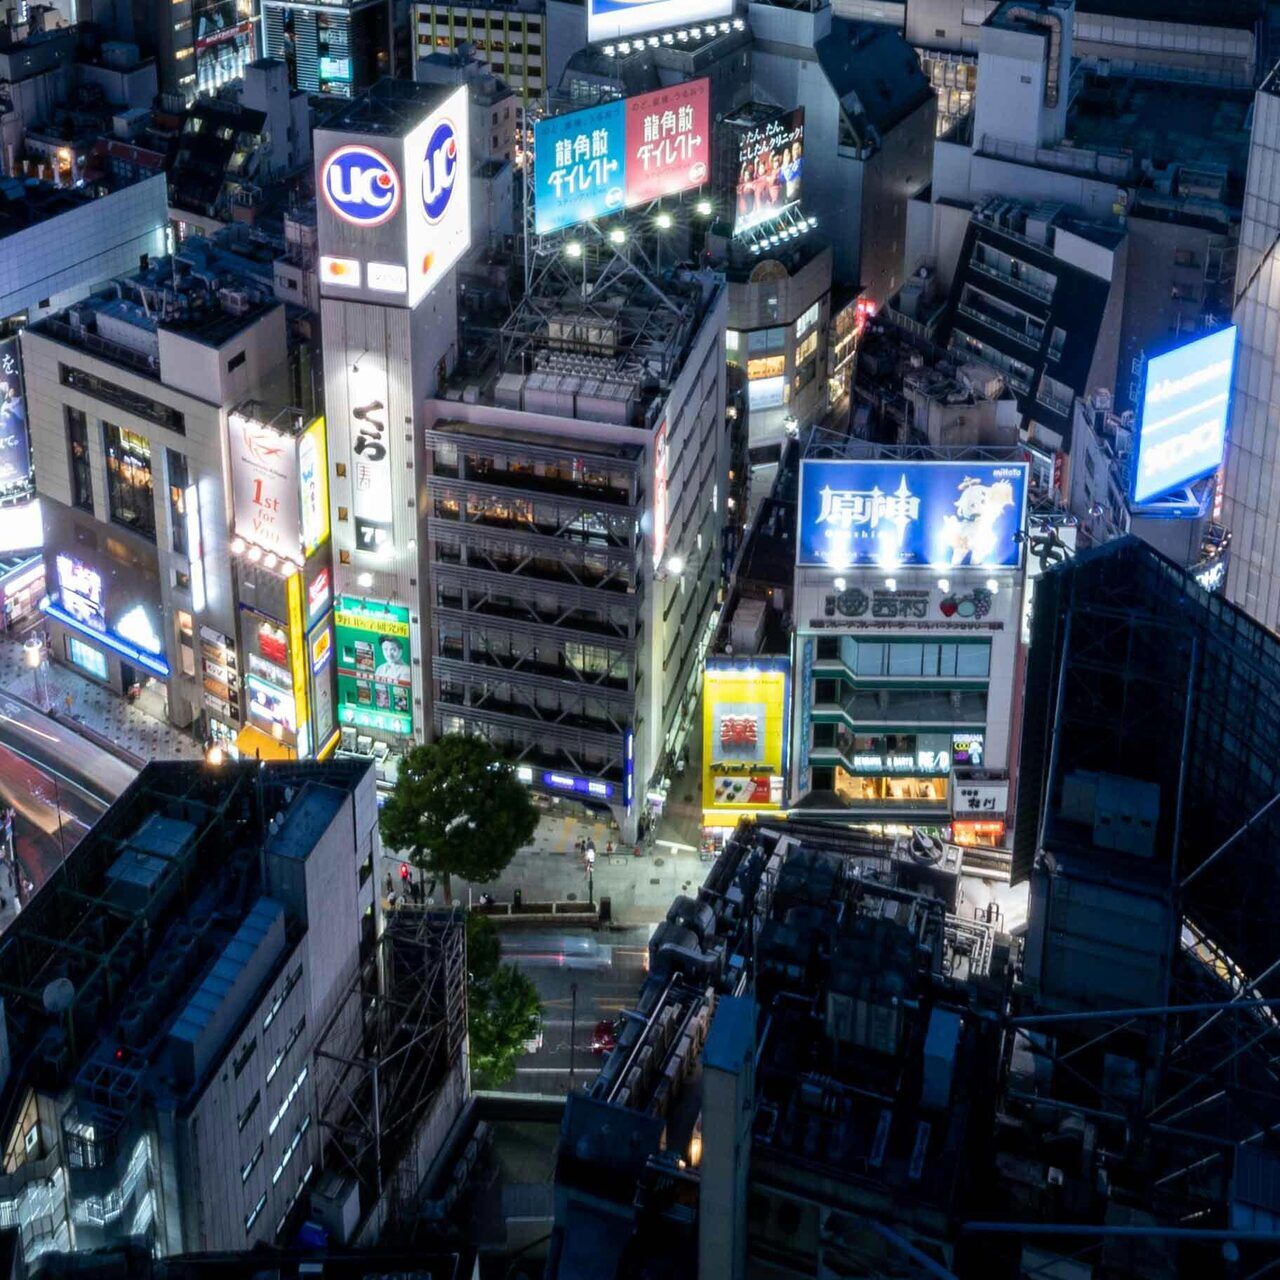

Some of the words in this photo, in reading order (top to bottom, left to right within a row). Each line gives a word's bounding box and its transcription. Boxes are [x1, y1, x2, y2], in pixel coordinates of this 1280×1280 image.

[643, 104, 694, 143] 龍角散
[555, 128, 608, 168] 龍角散
[637, 132, 702, 170] ダイレクト
[548, 157, 618, 198] ダイレクト
[353, 400, 387, 462] くら
[252, 478, 280, 511] 1st
[816, 473, 920, 544] 原神
